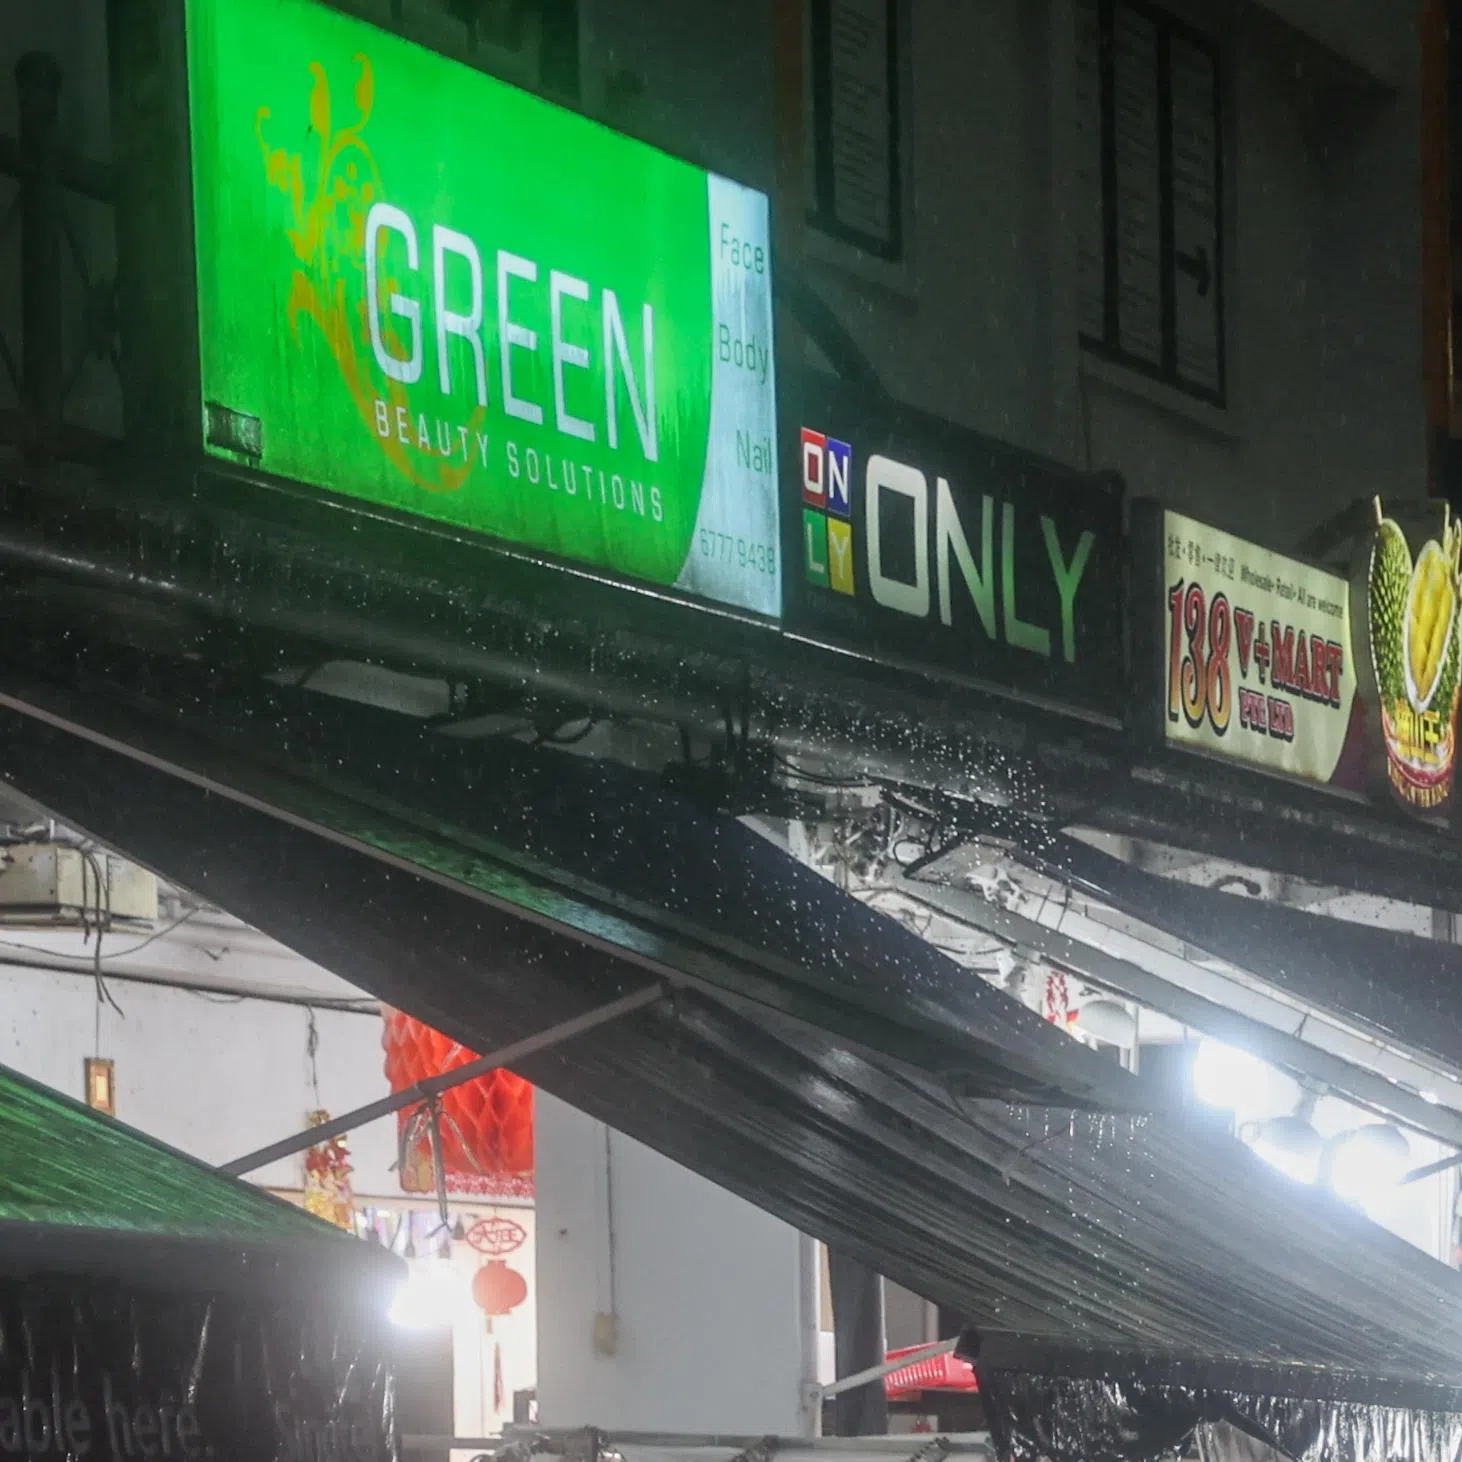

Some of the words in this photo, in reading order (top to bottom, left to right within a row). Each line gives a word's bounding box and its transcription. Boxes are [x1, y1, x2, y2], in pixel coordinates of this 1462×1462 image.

[720, 222, 765, 275] Face
[363, 202, 660, 463] GREEN
[719, 323, 769, 385] Body
[375, 399, 489, 469] BEAUTY
[507, 443, 664, 523] SOLUTIONS
[735, 429, 772, 475] Nail
[866, 453, 1095, 662] ONLY
[1168, 577, 1232, 737] 138
[1239, 686, 1266, 735] PTE
[1268, 696, 1294, 743] LTD
